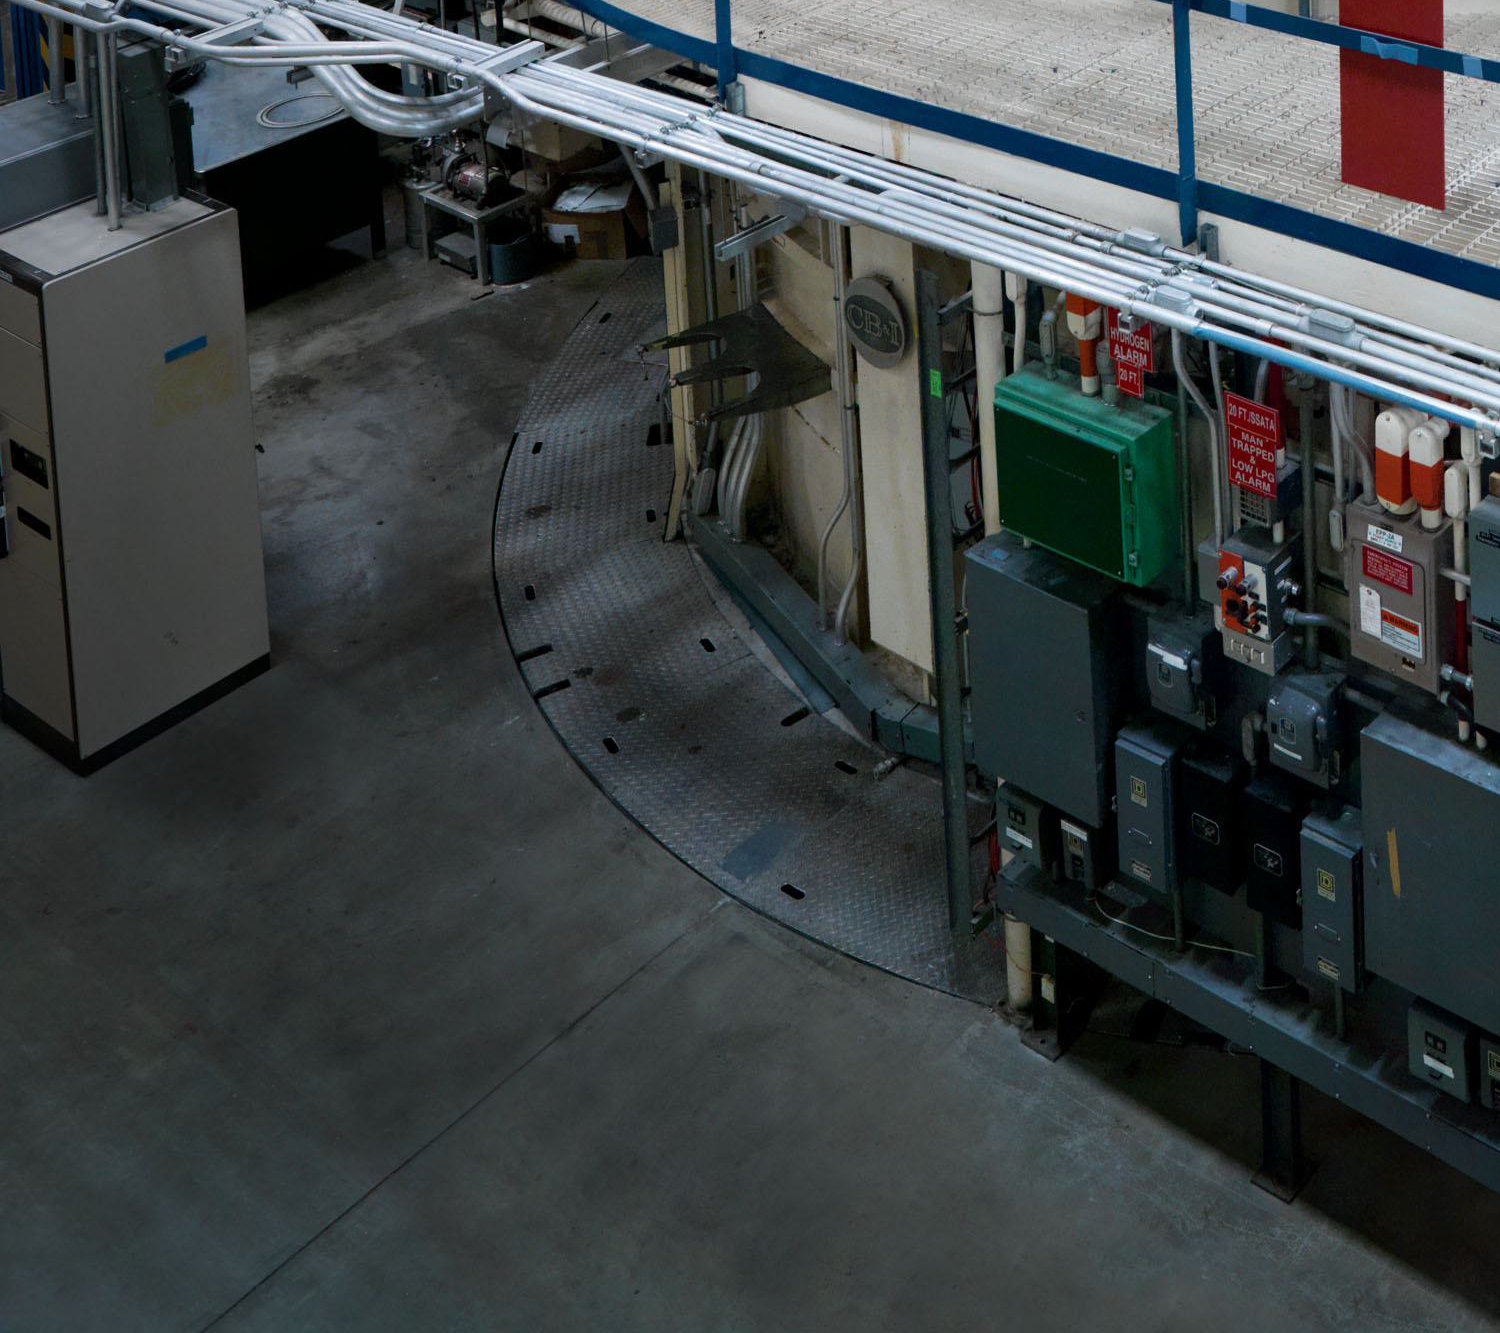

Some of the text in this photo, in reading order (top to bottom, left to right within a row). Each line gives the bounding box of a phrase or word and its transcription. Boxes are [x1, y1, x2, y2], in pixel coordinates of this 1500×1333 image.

[1110, 326, 1150, 352] HYDROGEN
[1114, 343, 1148, 367] ALARM
[1120, 367, 1128, 382] 20
[1229, 403, 1237, 417] 20
[1241, 431, 1264, 448] MAN
[1231, 437, 1275, 463] TRAPPED
[1249, 455, 1256, 465] &
[1232, 458, 1275, 483] LOW LPG
[1235, 471, 1271, 493] ALARM
[1389, 615, 1418, 633] WARNING
